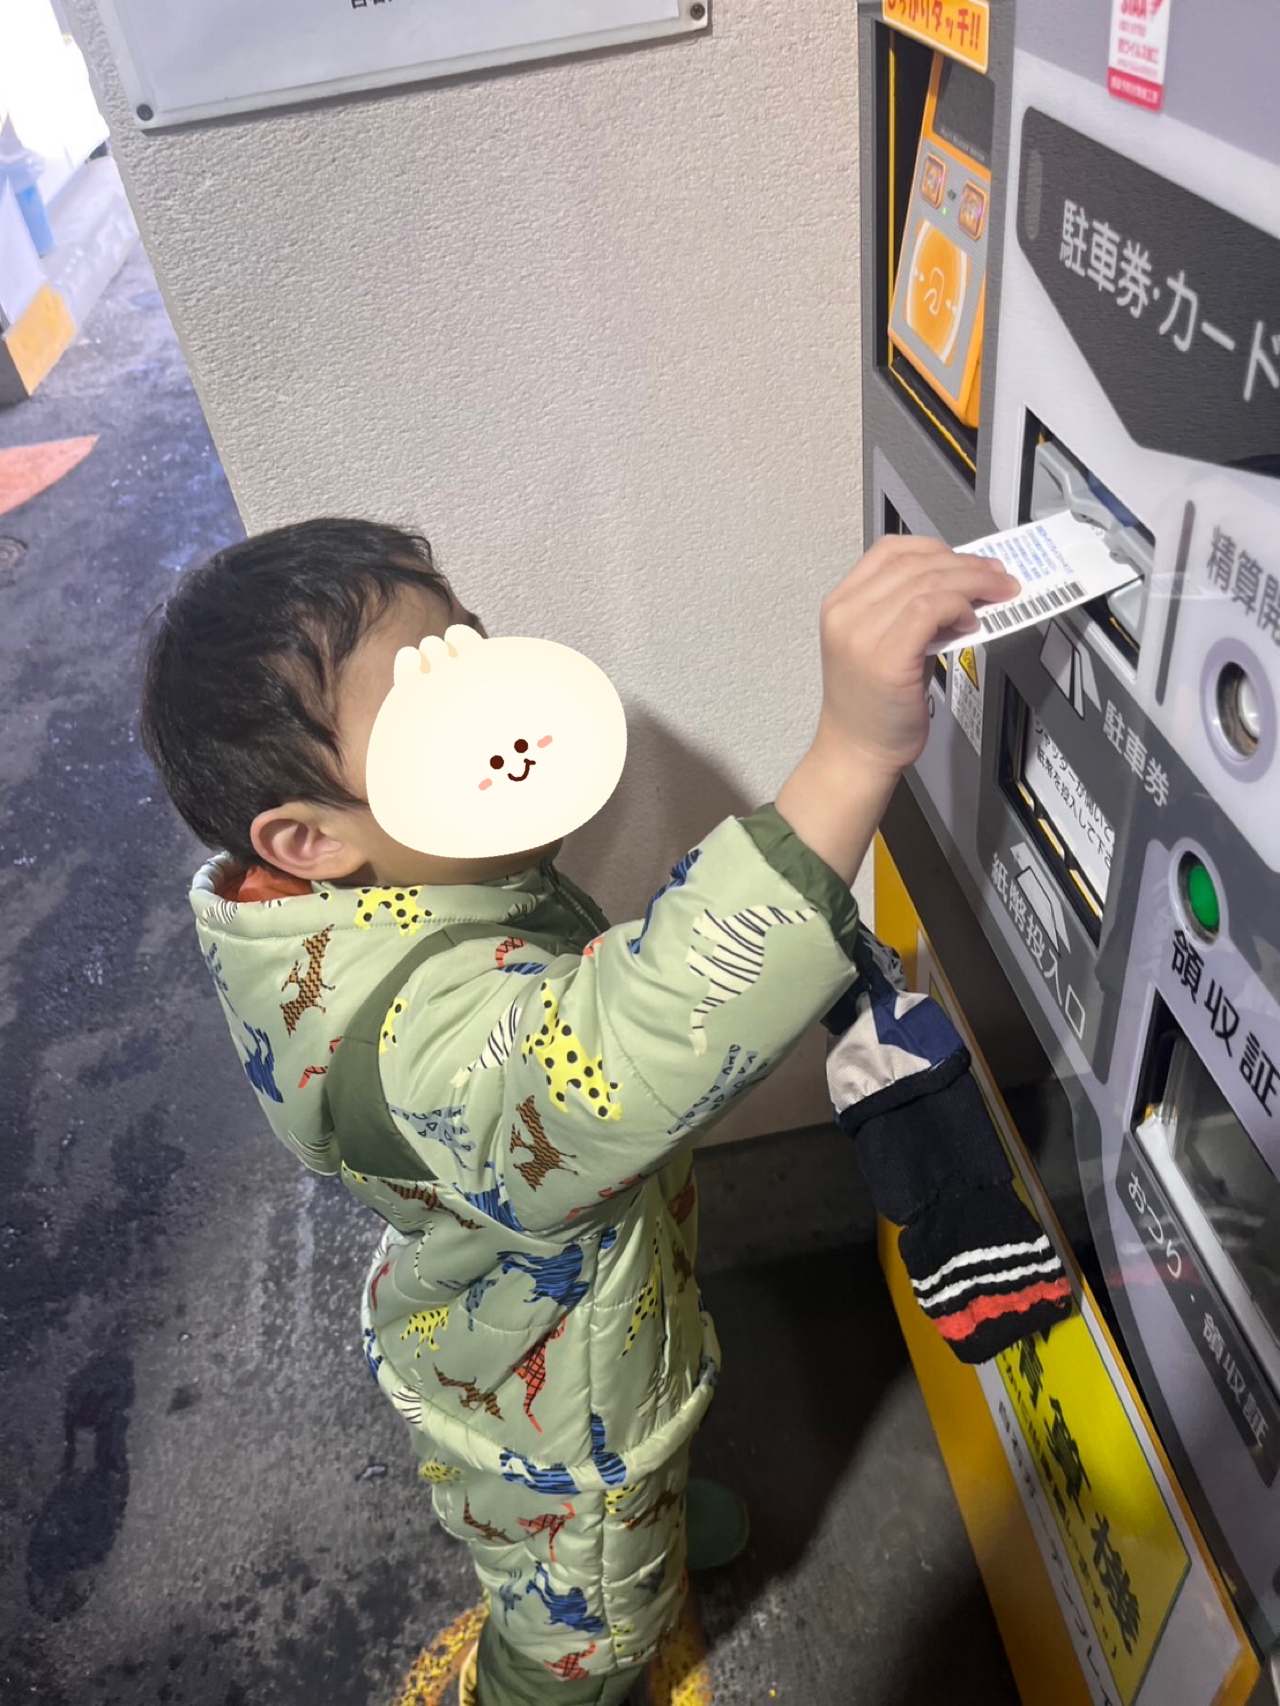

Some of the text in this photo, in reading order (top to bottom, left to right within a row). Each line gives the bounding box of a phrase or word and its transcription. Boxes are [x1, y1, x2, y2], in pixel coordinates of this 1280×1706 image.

[1059, 199, 1280, 402] 駐車券・カード
[1103, 699, 1170, 808] 駐車券
[991, 852, 1086, 1041] 紙幣投入口
[1171, 929, 1280, 1118] 領収証
